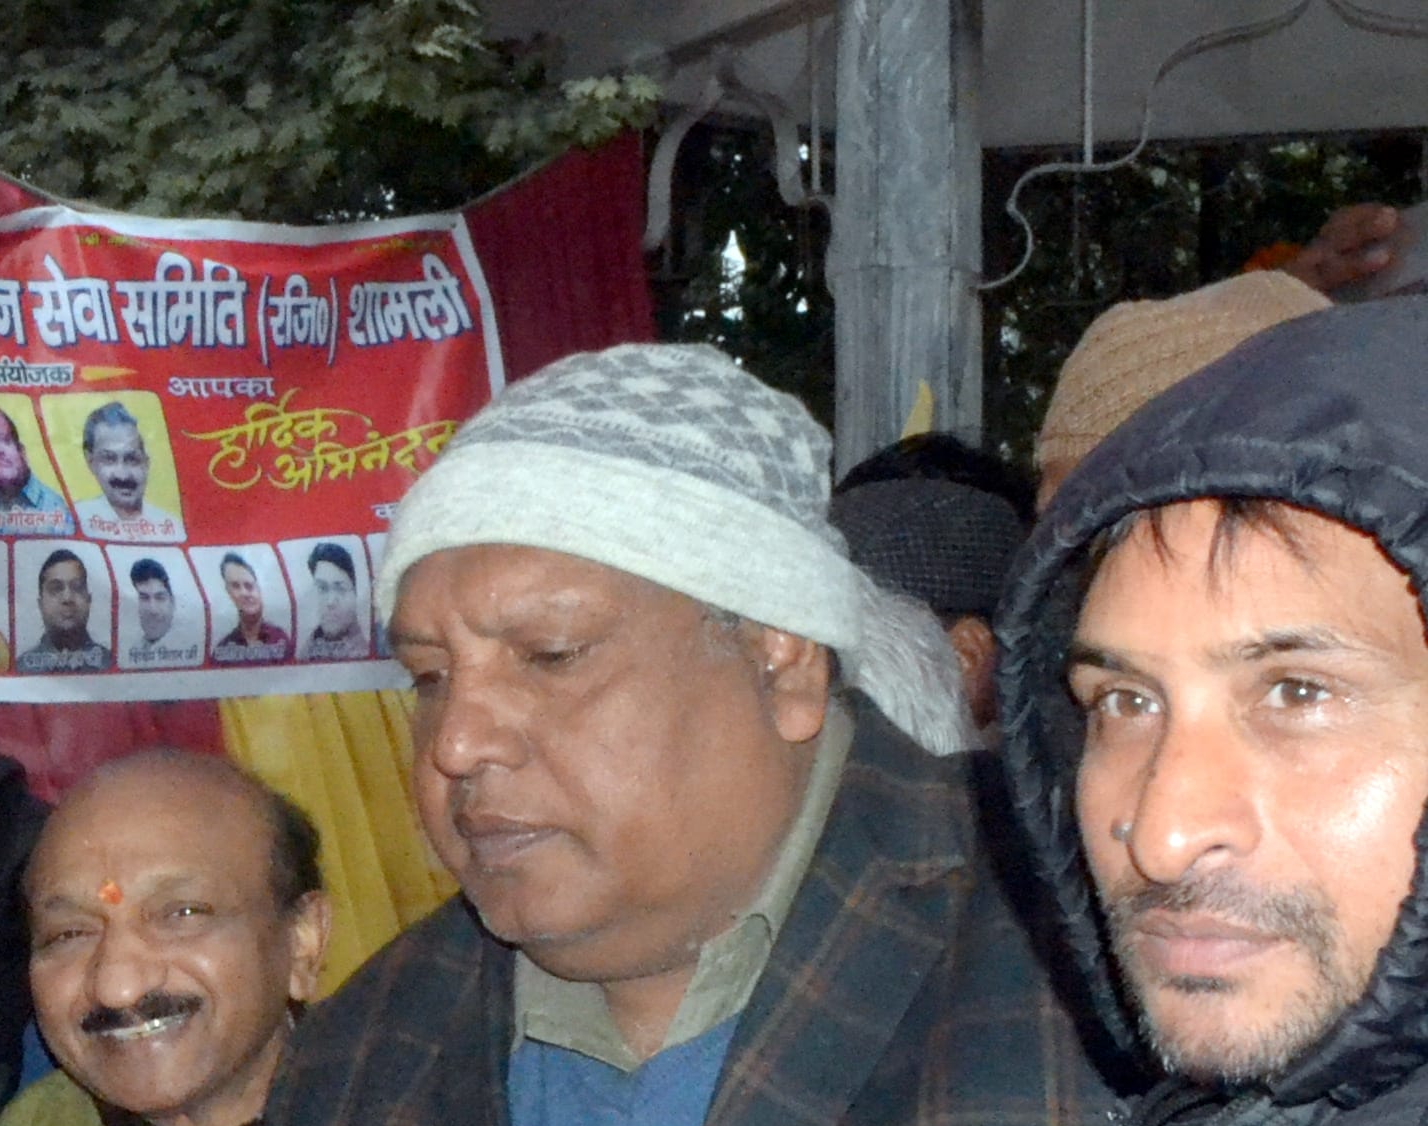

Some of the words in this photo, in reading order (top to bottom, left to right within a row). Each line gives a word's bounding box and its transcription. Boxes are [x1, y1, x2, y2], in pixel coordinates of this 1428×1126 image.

[27, 253, 120, 347] सेवा
[116, 251, 247, 348] समिति
[348, 253, 473, 348] शामली
[168, 375, 275, 398] आपका
